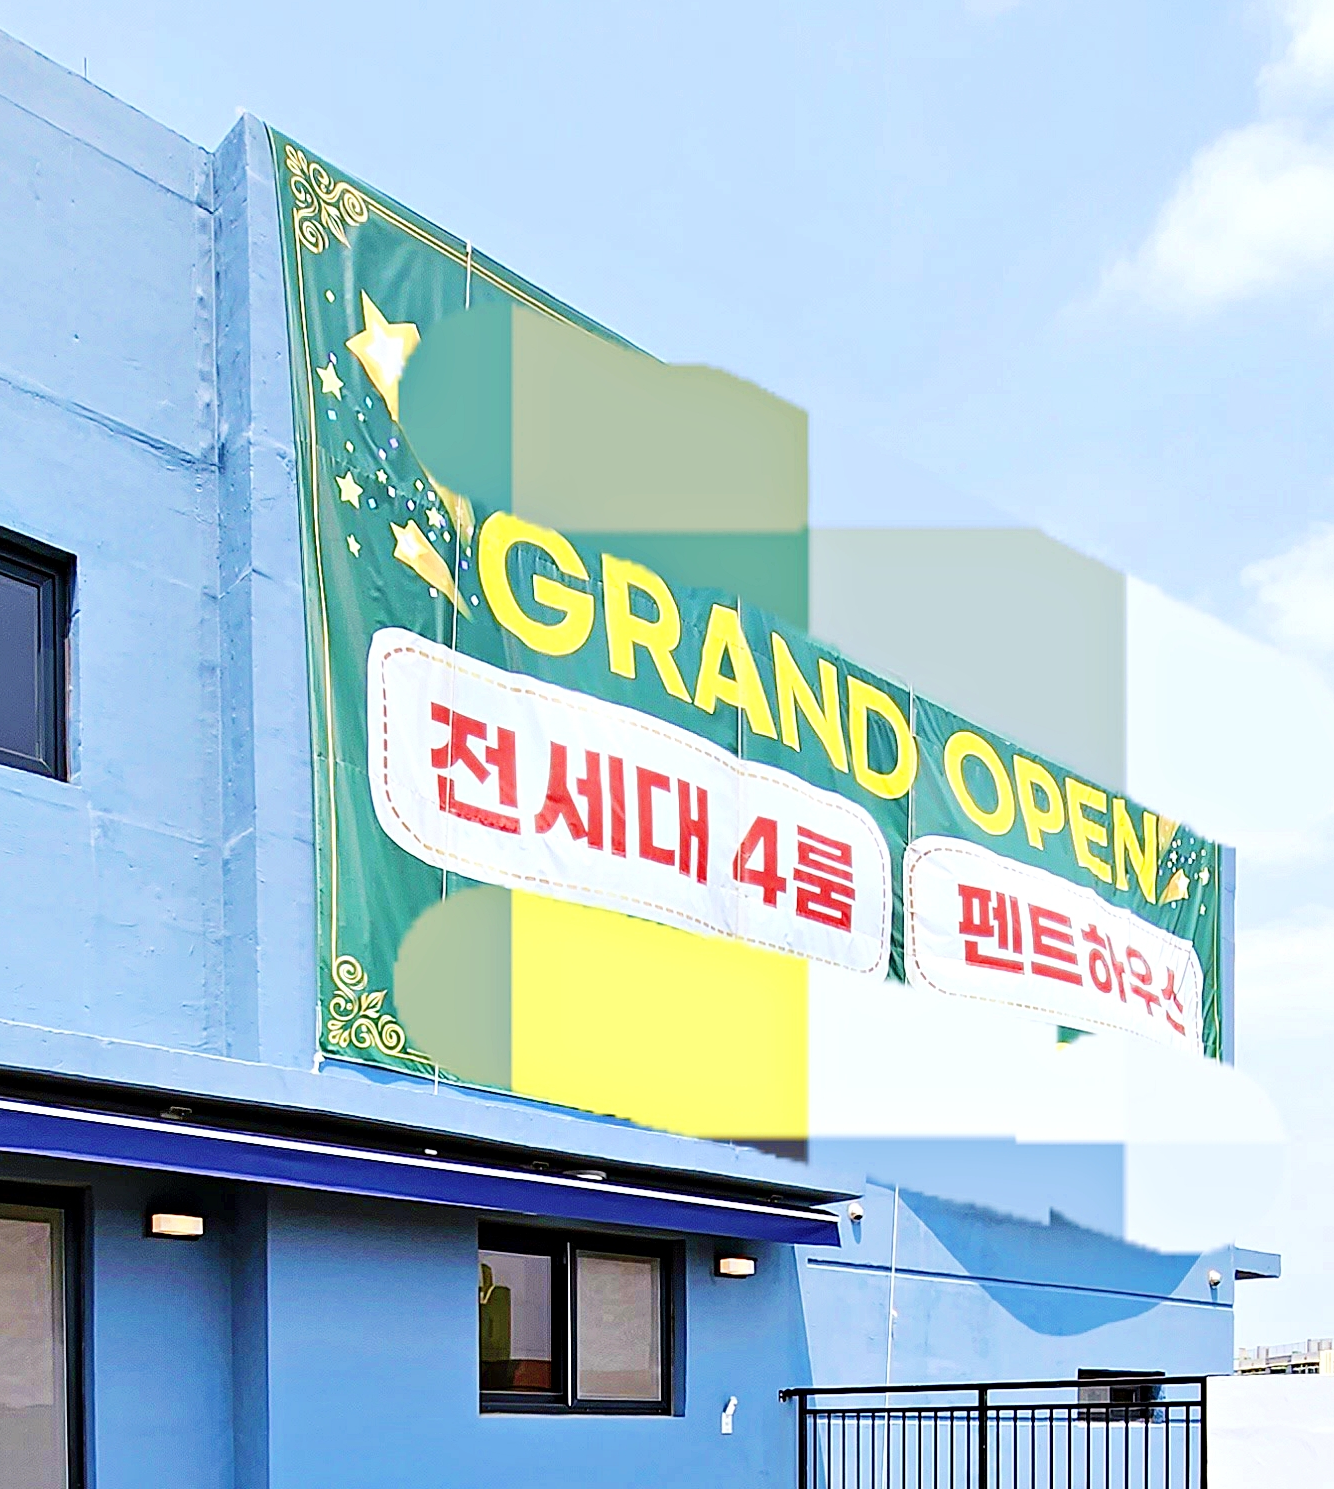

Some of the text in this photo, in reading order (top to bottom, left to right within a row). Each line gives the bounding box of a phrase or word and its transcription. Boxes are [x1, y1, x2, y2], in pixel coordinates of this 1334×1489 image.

[478, 511, 1158, 906] GRAND OPEN
[733, 816, 856, 934] 4룸
[957, 882, 1187, 1037] 펜트하우스
